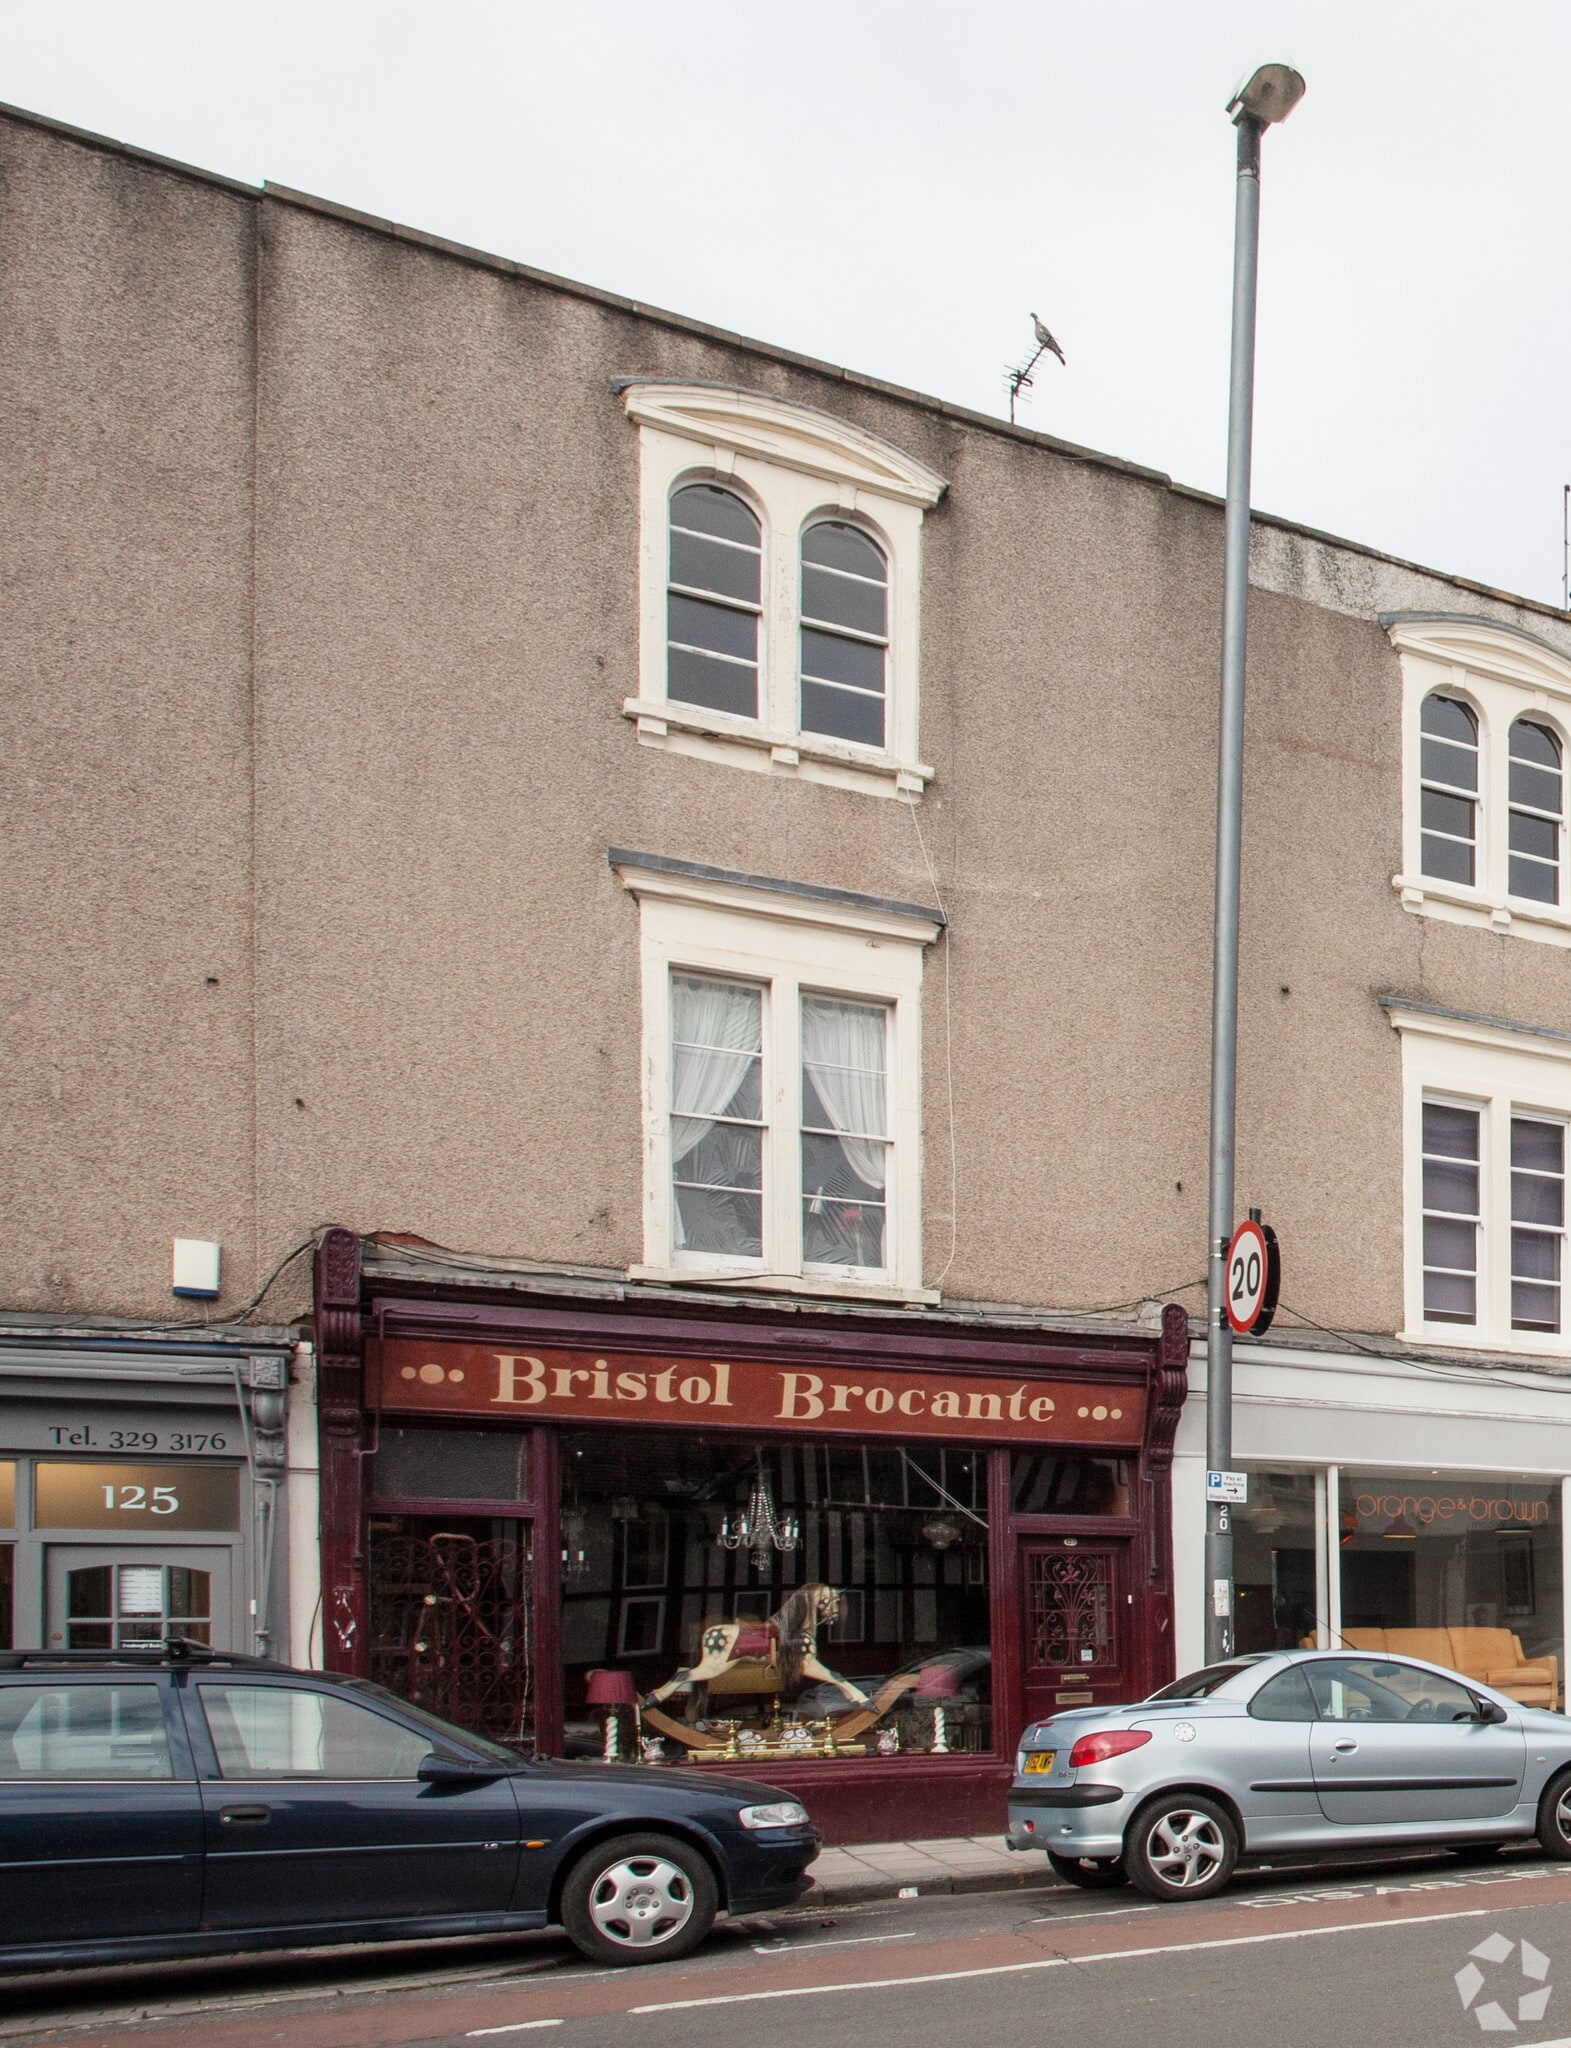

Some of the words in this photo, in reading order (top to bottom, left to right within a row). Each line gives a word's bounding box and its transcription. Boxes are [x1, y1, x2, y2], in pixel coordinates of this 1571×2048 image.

[1232, 1251, 1261, 1301] 20
[490, 1353, 733, 1406] Bristol
[773, 1371, 1056, 1422] Brocante
[49, 1426, 97, 1446] Tel.
[109, 1431, 158, 1450] 329
[169, 1432, 226, 1451] 3176
[1211, 1474, 1220, 1486] P
[101, 1485, 180, 1514] 125
[1209, 1493, 1228, 1501] Display
[1235, 1868, 1571, 1908] DISABLE
